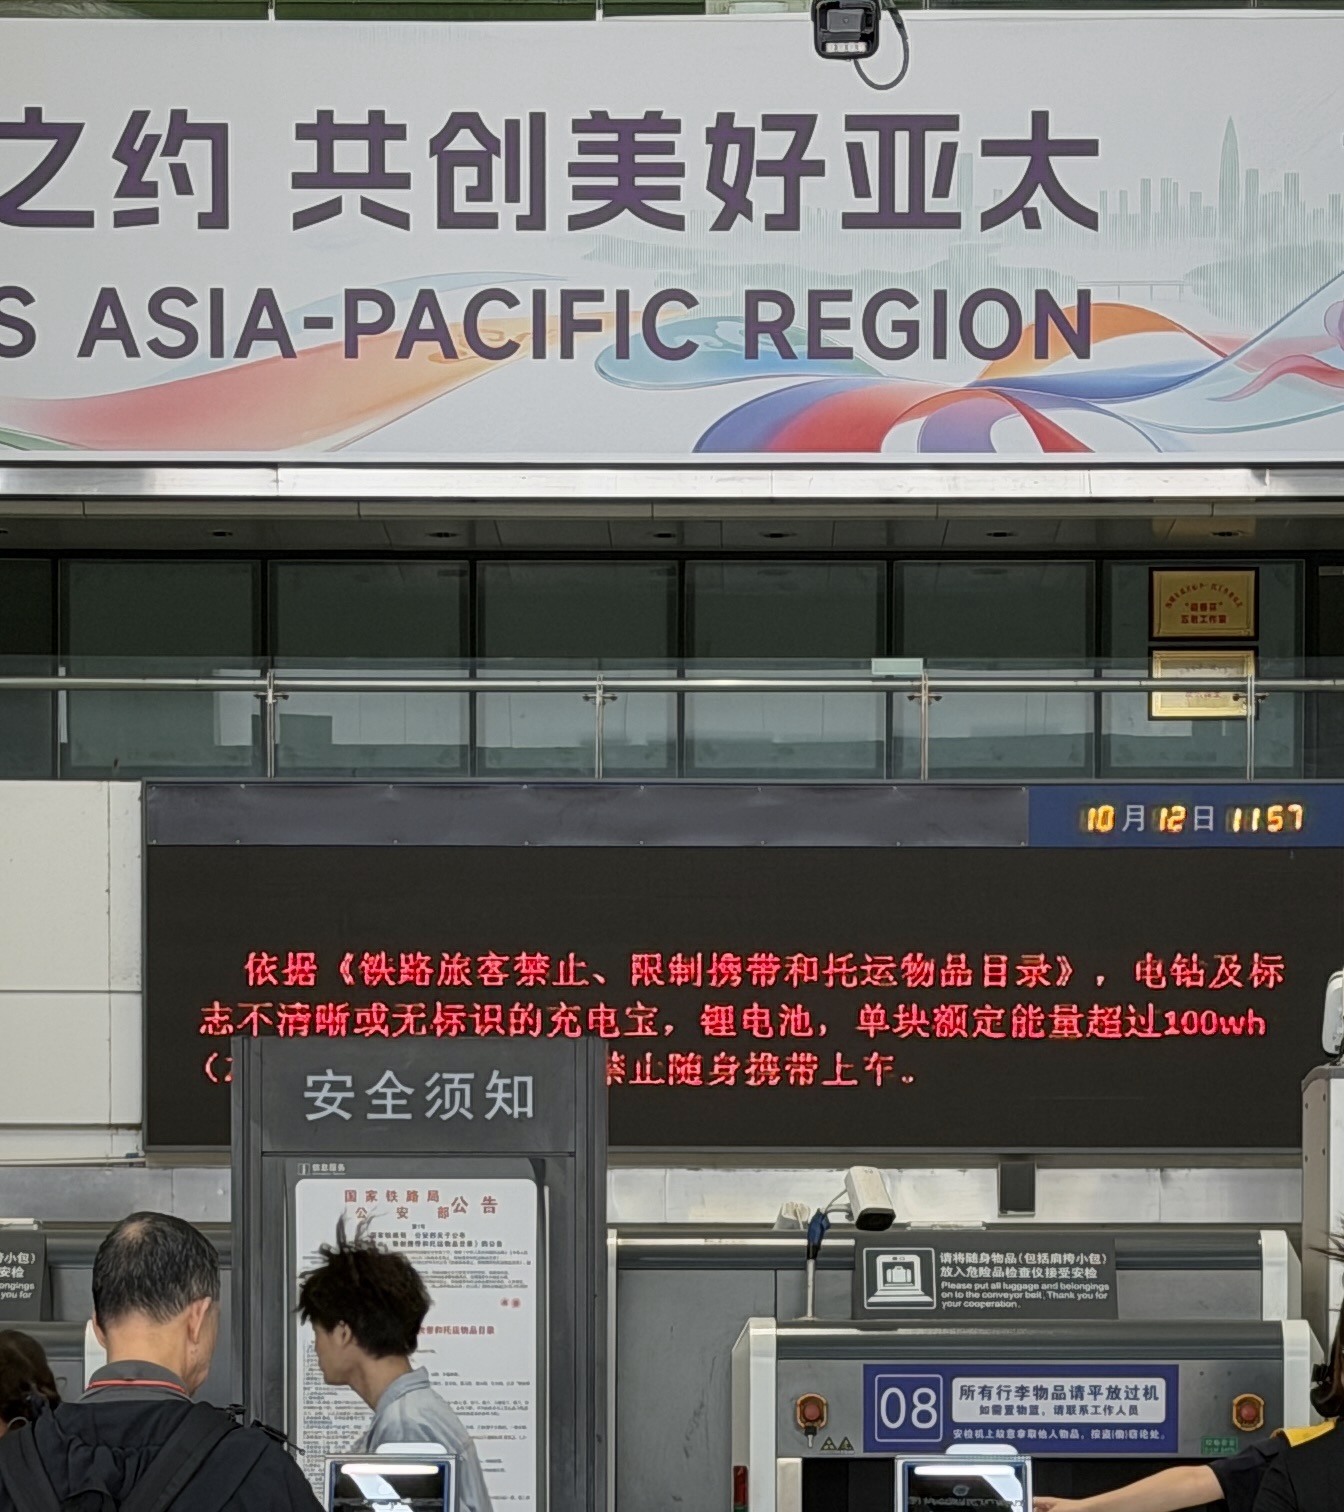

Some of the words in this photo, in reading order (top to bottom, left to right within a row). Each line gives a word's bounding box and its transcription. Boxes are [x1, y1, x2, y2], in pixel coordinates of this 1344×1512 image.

[292, 110, 1099, 232] 共创美好亚太
[77, 286, 700, 360] ASIA-PACIFIC
[745, 288, 1093, 361] REGION
[304, 1069, 535, 1121] 安全须知
[344, 1190, 440, 1203] 国家铁路局
[451, 1196, 498, 1213] 公告
[355, 1206, 450, 1219] 公安部
[940, 1267, 1097, 1279] 放入危险品检查仪接受安检
[959, 1384, 1159, 1400] 所有行李物品请平放过机
[880, 1387, 937, 1429] 08
